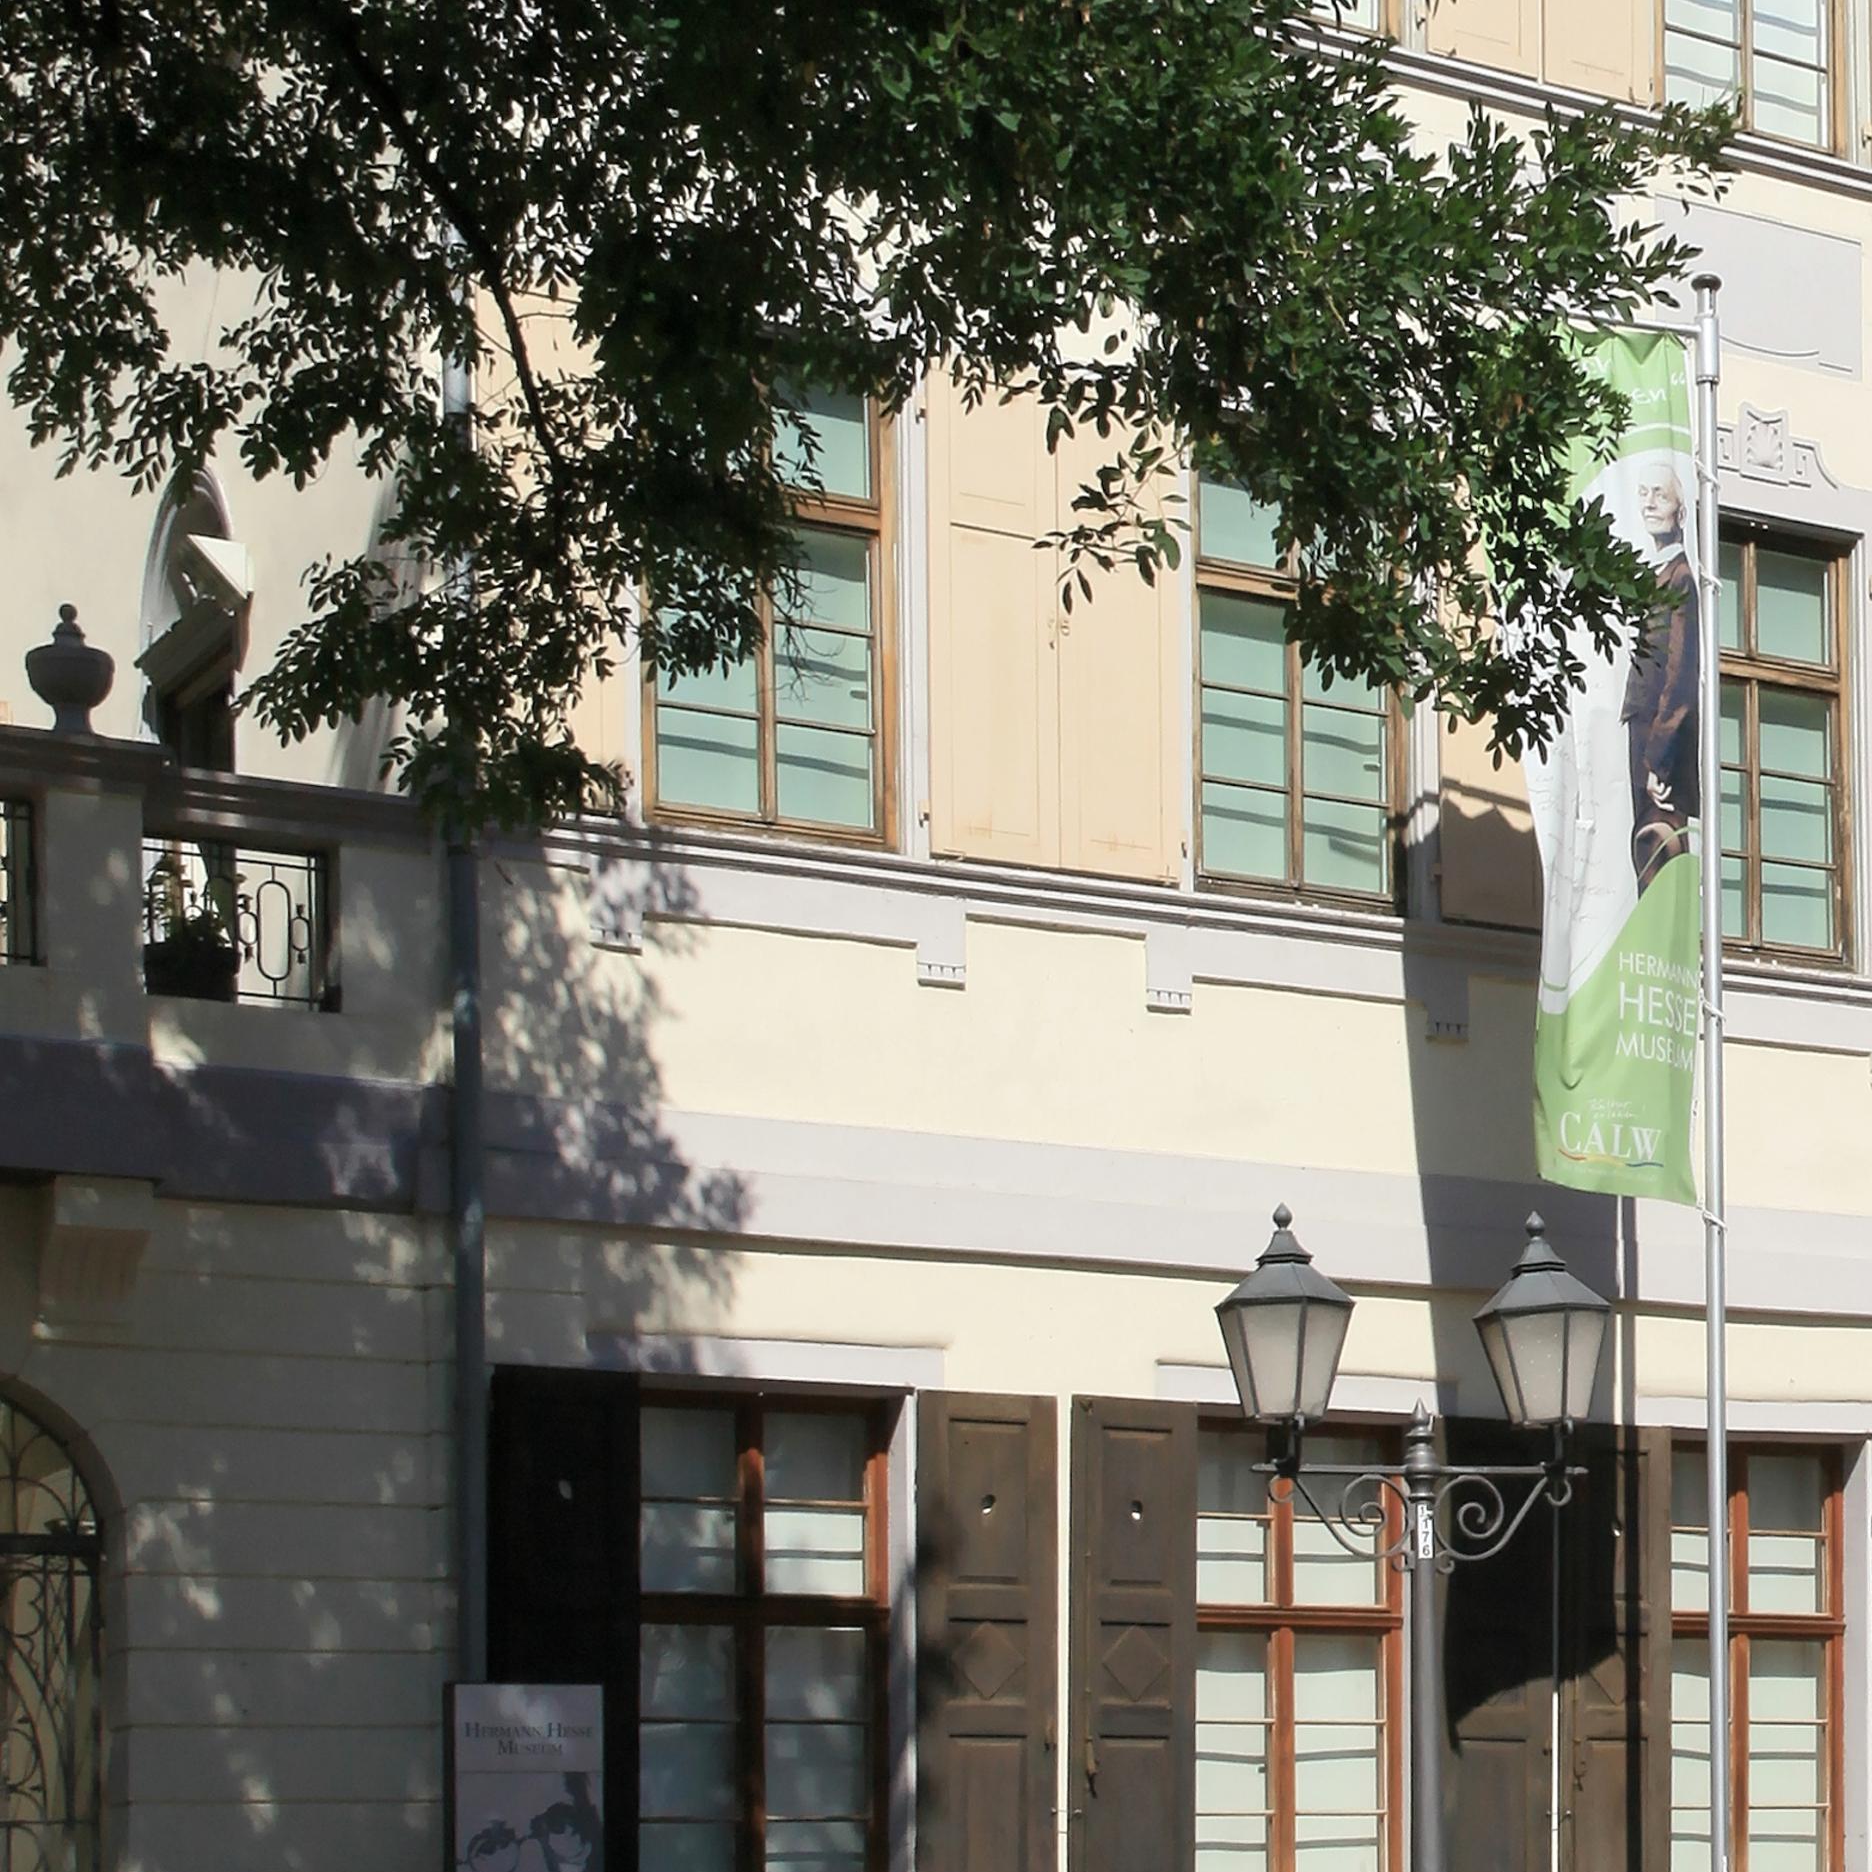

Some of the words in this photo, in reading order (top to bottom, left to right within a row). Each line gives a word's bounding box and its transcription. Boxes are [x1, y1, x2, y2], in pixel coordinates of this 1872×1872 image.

[1618, 951, 1698, 990] HERMANN
[1618, 981, 1697, 1037] HESSE
[1615, 1031, 1694, 1072] MUSEUM
[1560, 1111, 1661, 1159] CALW
[464, 1721, 541, 1738] HERMANN
